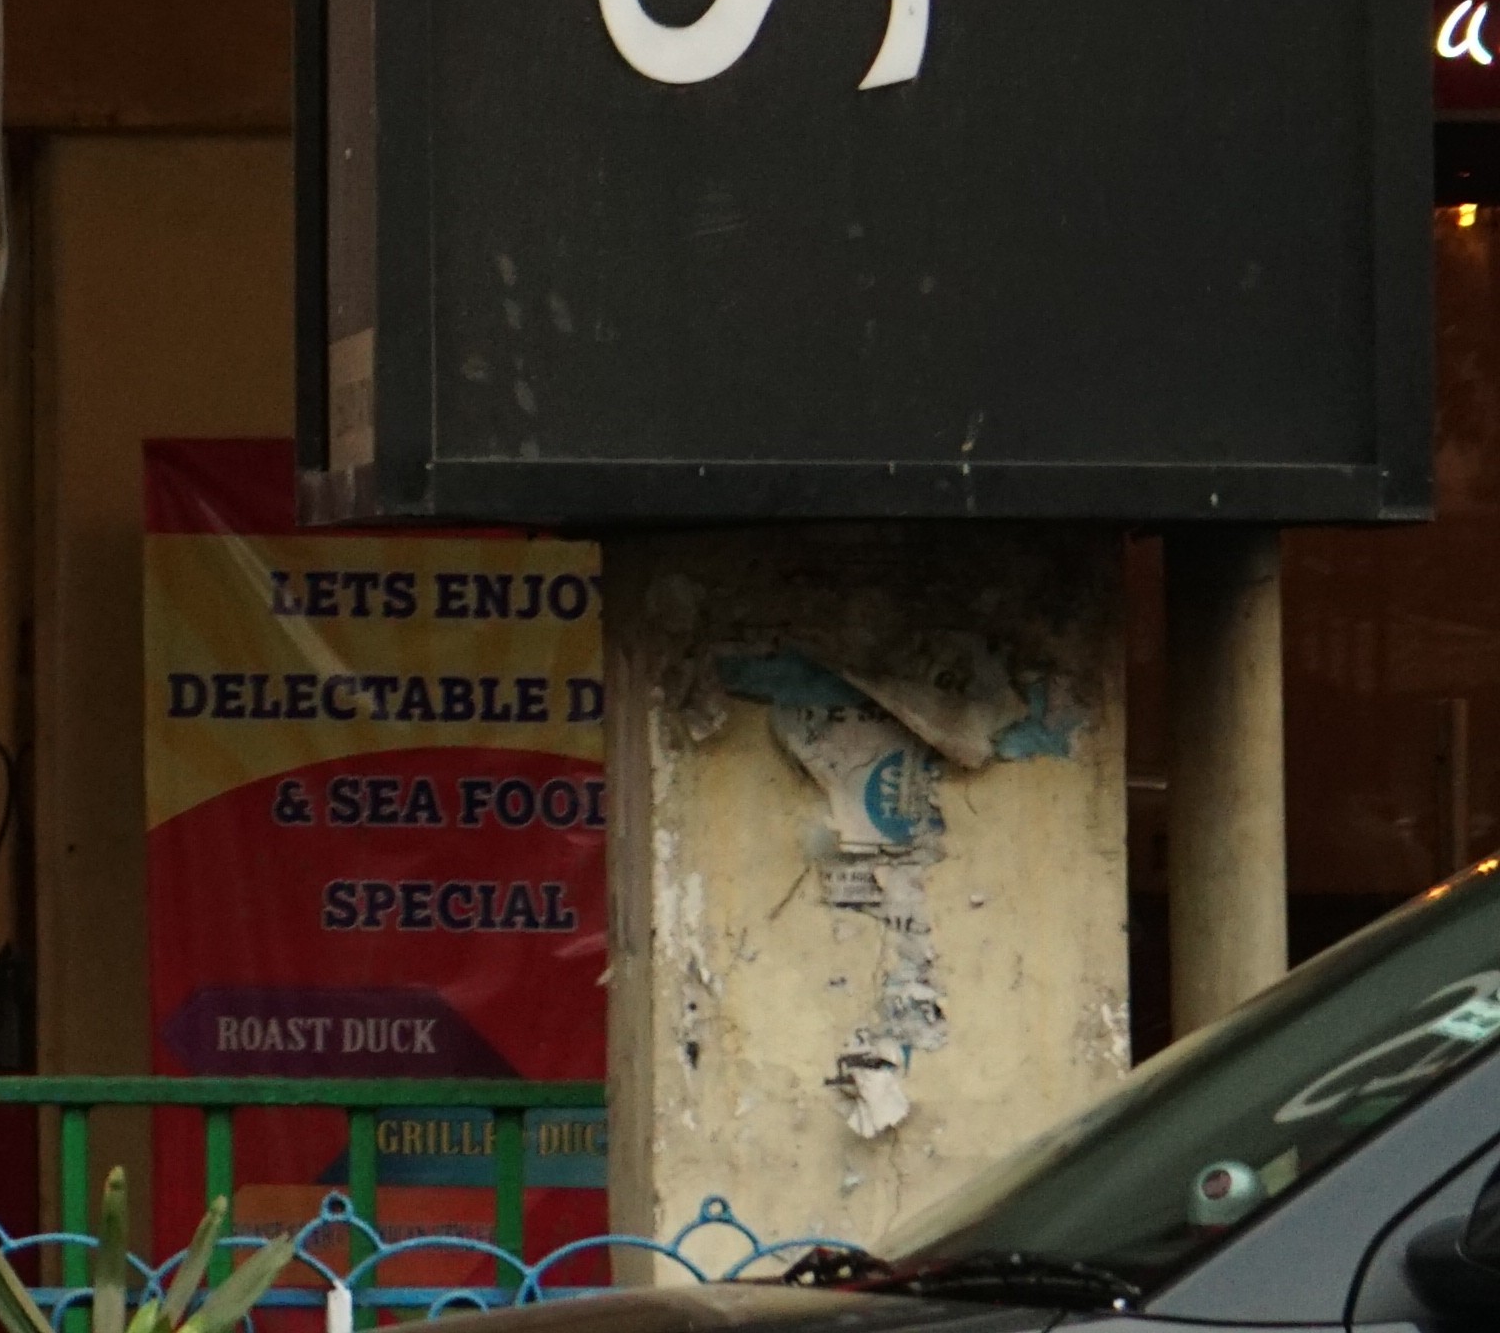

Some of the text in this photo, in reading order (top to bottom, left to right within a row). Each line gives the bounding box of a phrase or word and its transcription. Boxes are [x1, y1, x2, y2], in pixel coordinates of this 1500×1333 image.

[269, 569, 418, 620] LETS
[166, 672, 550, 725] DELECTABLE
[271, 778, 312, 826] &
[326, 779, 444, 827] SEA
[323, 880, 575, 932] SPECIAL
[216, 1015, 438, 1055] ROAST DUCK
